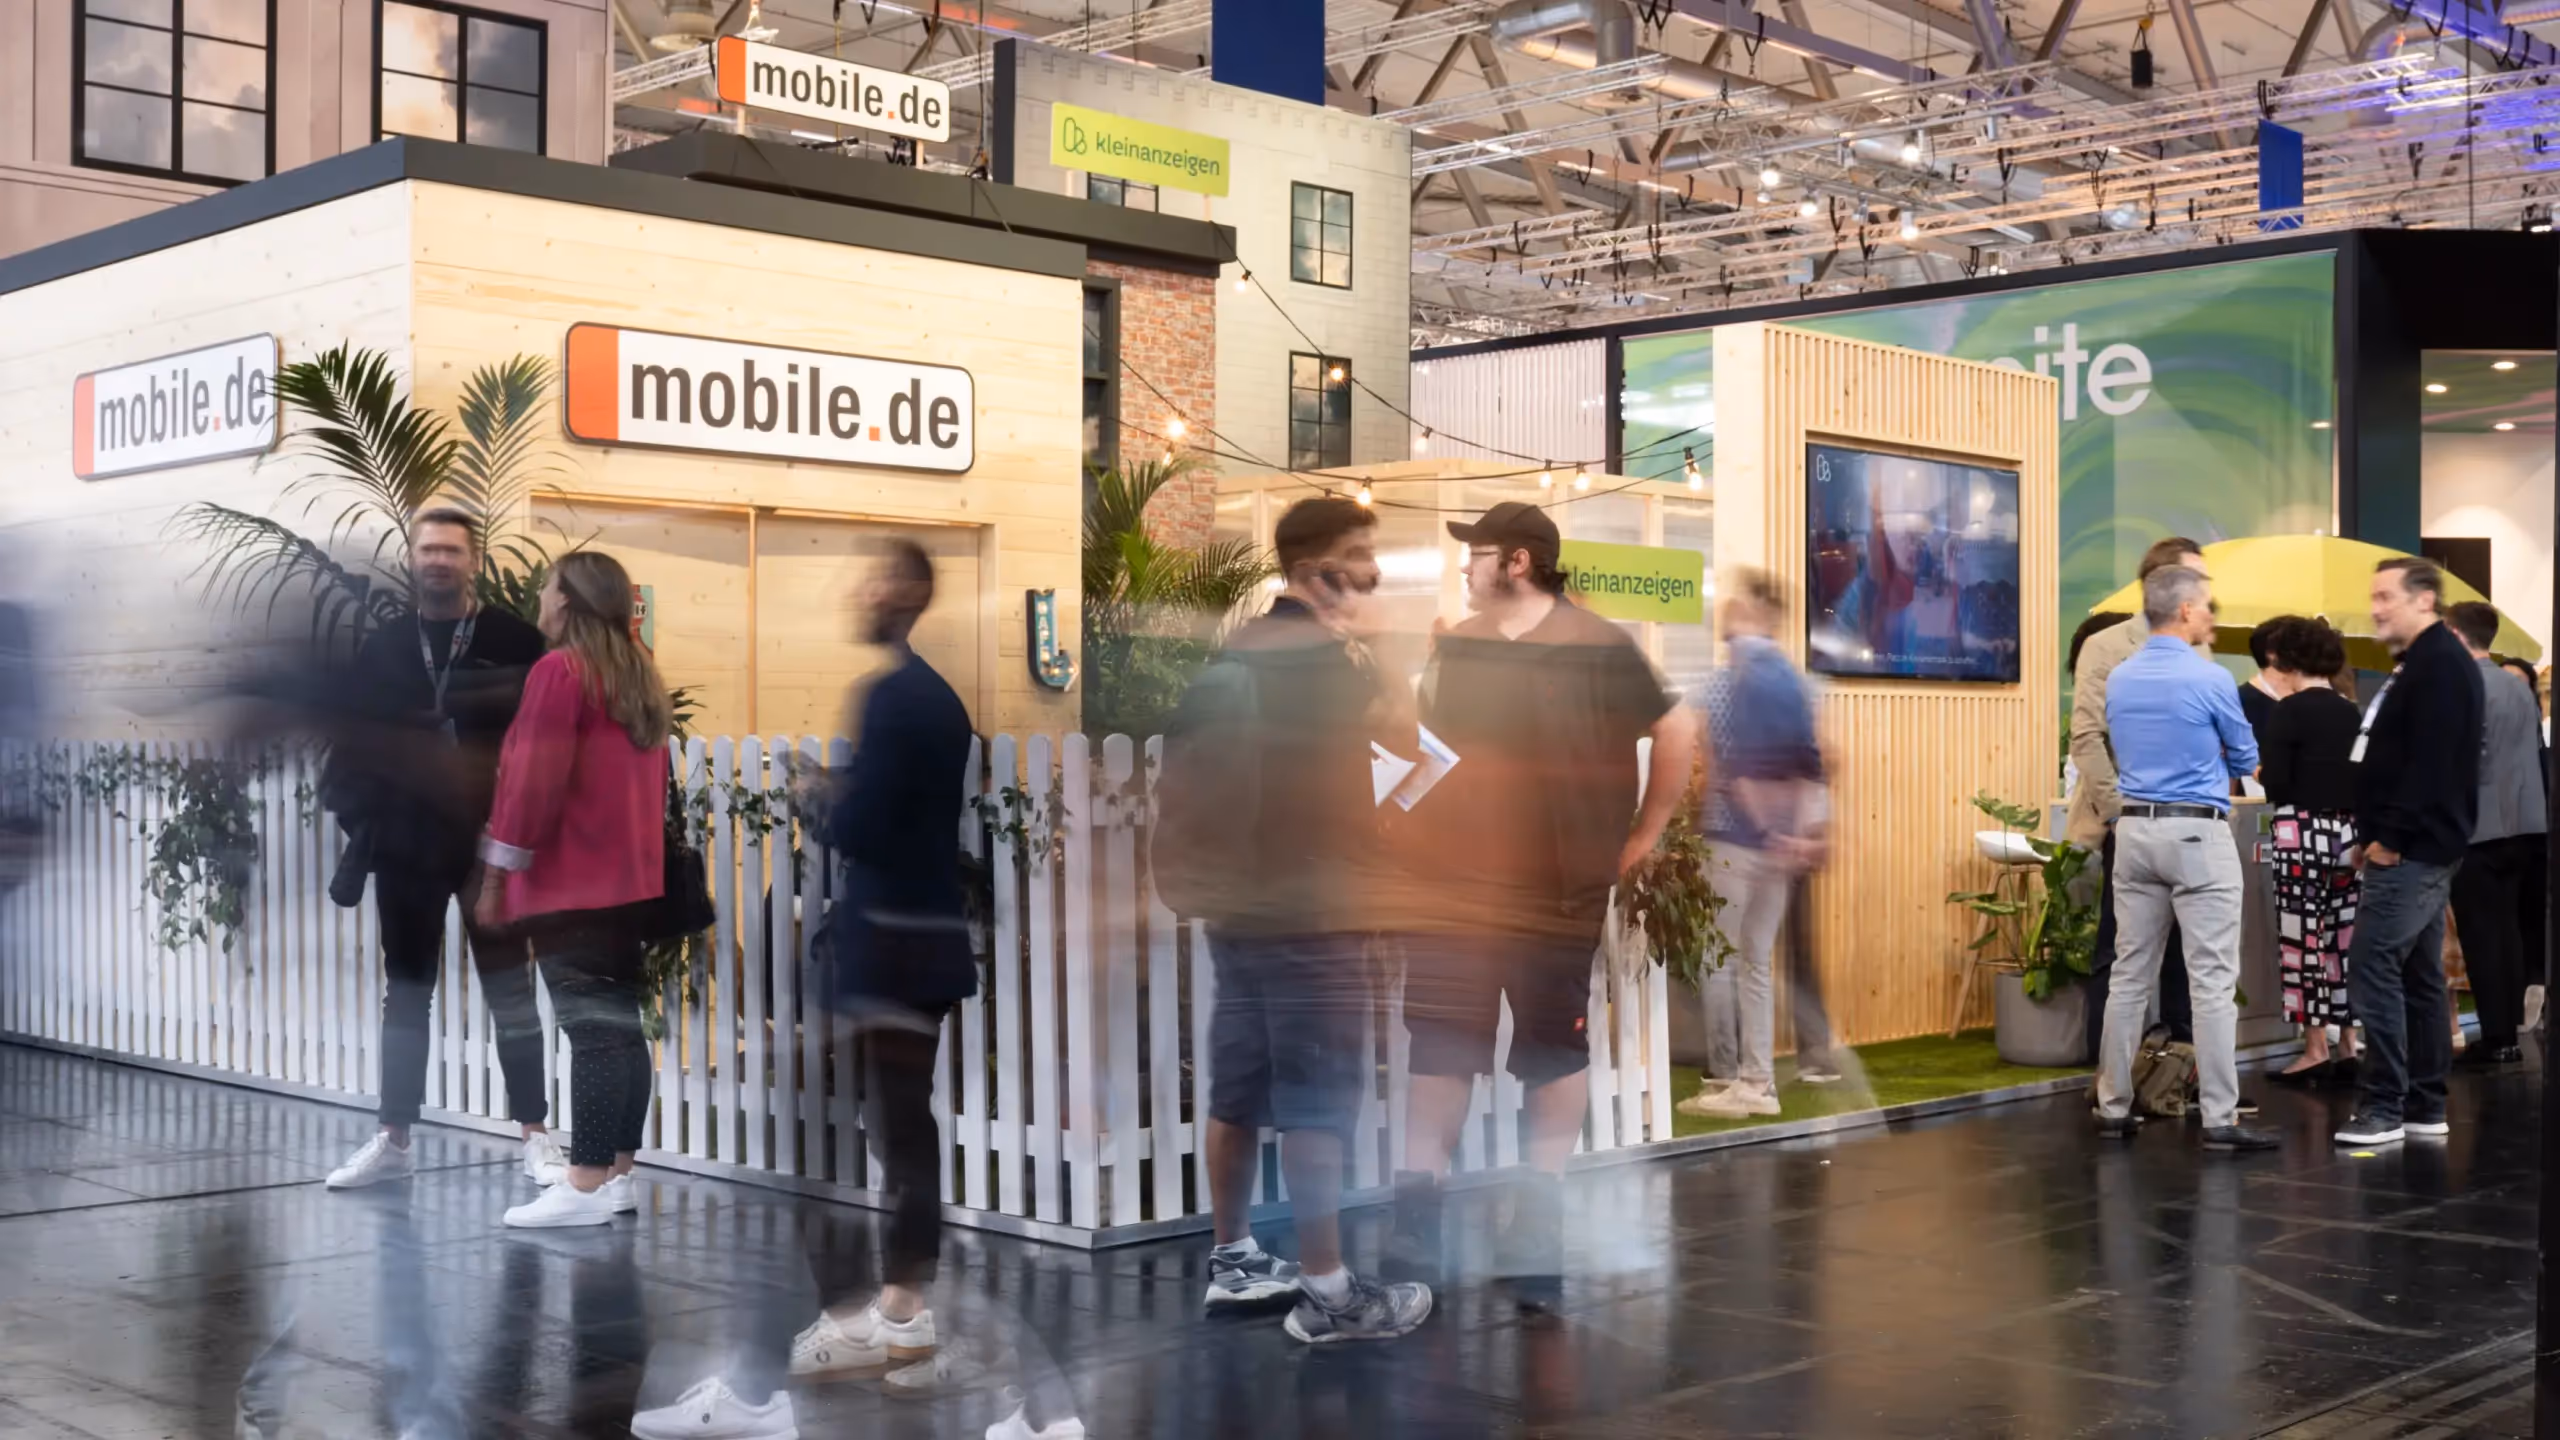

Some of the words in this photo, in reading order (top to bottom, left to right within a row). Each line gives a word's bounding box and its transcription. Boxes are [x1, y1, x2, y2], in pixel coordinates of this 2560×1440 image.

[753, 60, 941, 128] mobile.de
[1096, 131, 1220, 176] kleinanzeigen
[100, 356, 266, 451] mobile.de
[631, 358, 960, 449] mobile.de
[1973, 322, 2153, 420] ite
